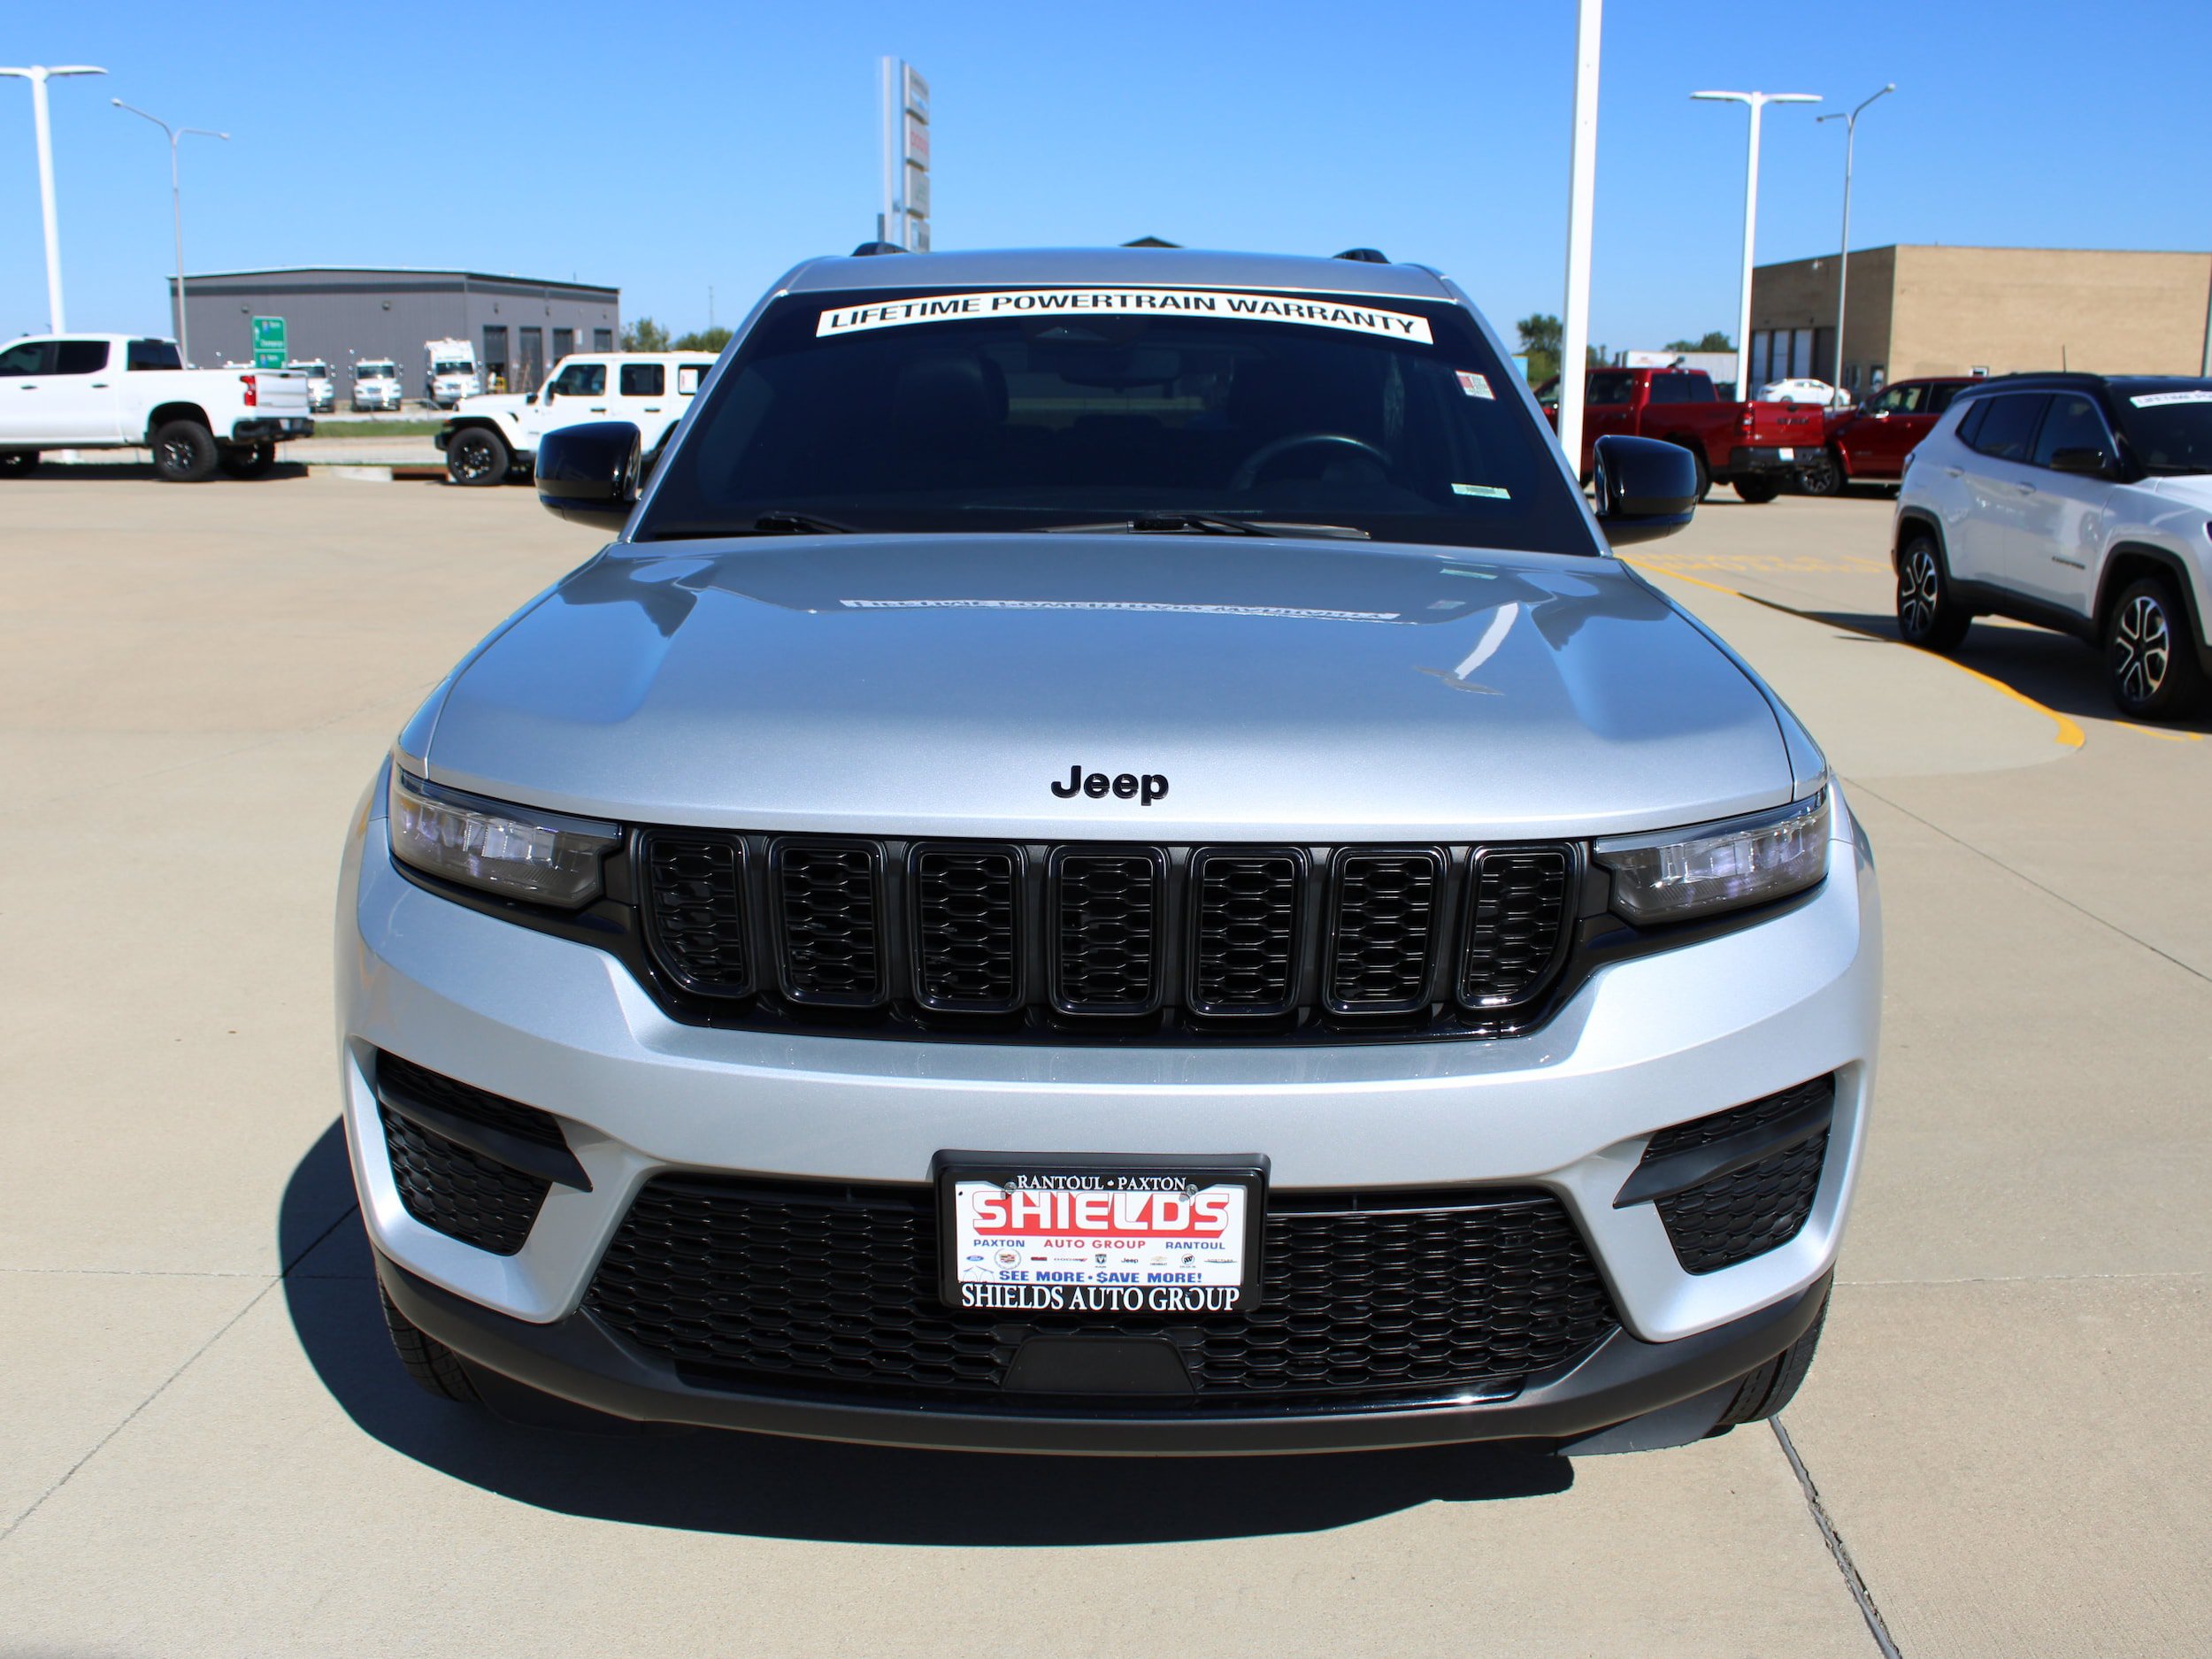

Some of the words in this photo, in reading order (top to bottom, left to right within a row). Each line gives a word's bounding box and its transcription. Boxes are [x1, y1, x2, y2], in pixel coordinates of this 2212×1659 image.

[831, 297, 981, 328] LIFETIME
[992, 294, 1216, 311] POWERTRAIN
[1226, 297, 1415, 334] WARRANTY
[1050, 764, 1169, 807] Jeep
[1018, 1175, 1104, 1190] RANTOUL
[1118, 1177, 1187, 1191] PAXTON
[972, 1190, 1230, 1238] SHIELDS
[973, 1239, 1025, 1248] PAXTON
[1043, 1239, 1086, 1249] AUTO
[1092, 1239, 1147, 1249] GROUP
[1165, 1241, 1225, 1250] RANTOUL
[999, 1271, 1029, 1281] SEE
[1036, 1271, 1085, 1282] MORE
[1147, 1272, 1202, 1283] MORE!
[962, 1284, 1064, 1310] SHIELDS
[1069, 1286, 1144, 1311] AUTO
[1148, 1286, 1240, 1311] GROUP
